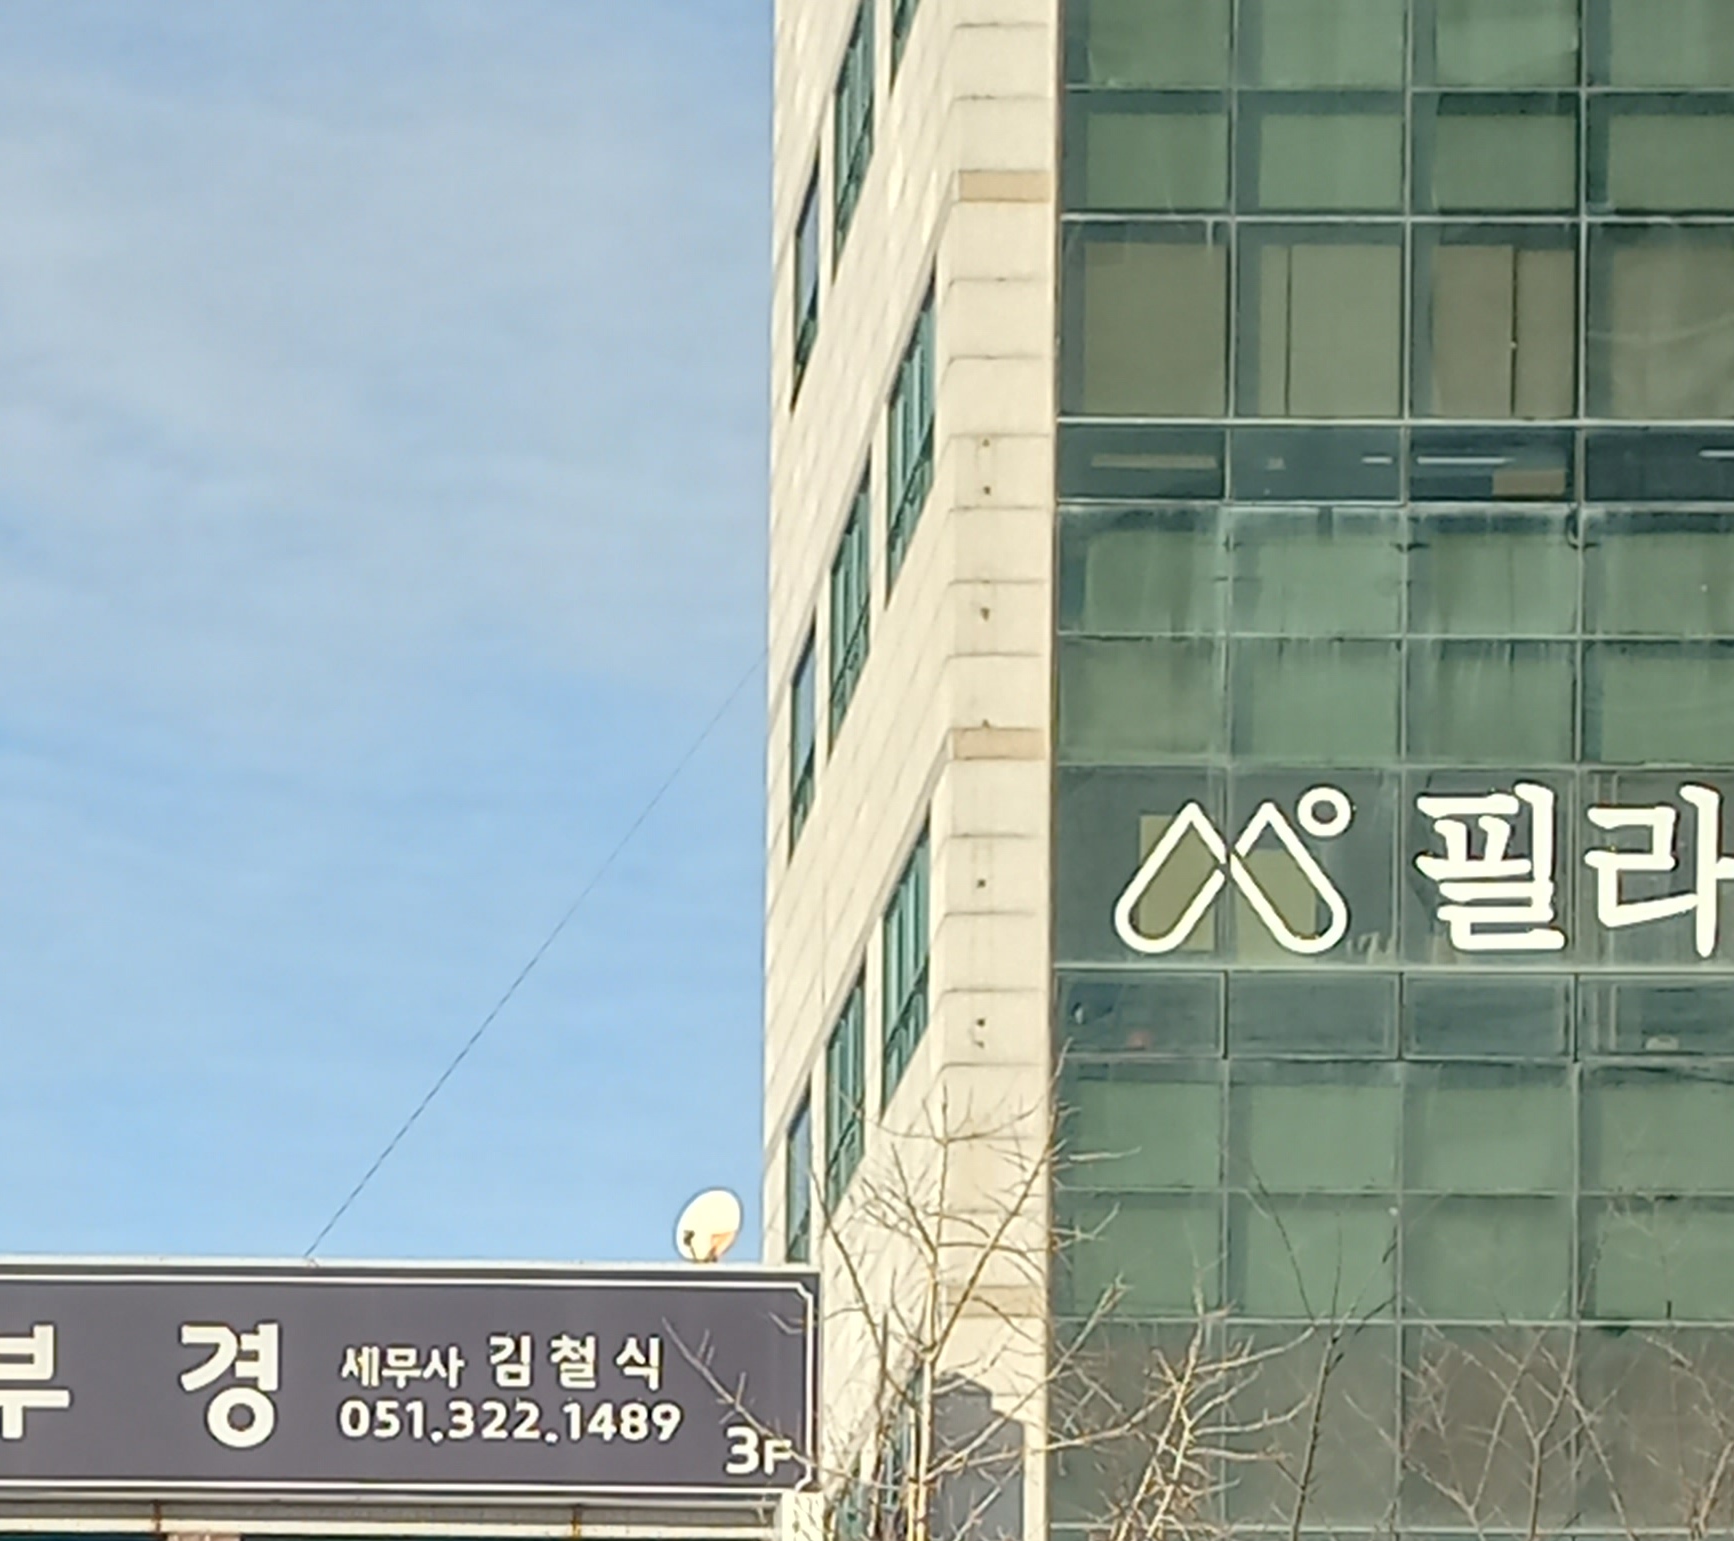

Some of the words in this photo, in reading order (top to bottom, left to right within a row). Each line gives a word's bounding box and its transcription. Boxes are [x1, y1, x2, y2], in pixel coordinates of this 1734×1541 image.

[1415, 781, 1734, 957] 필라
[341, 1344, 464, 1389] 세무사
[341, 1401, 682, 1445] 051.322.1489
[725, 1426, 793, 1475] 3F
